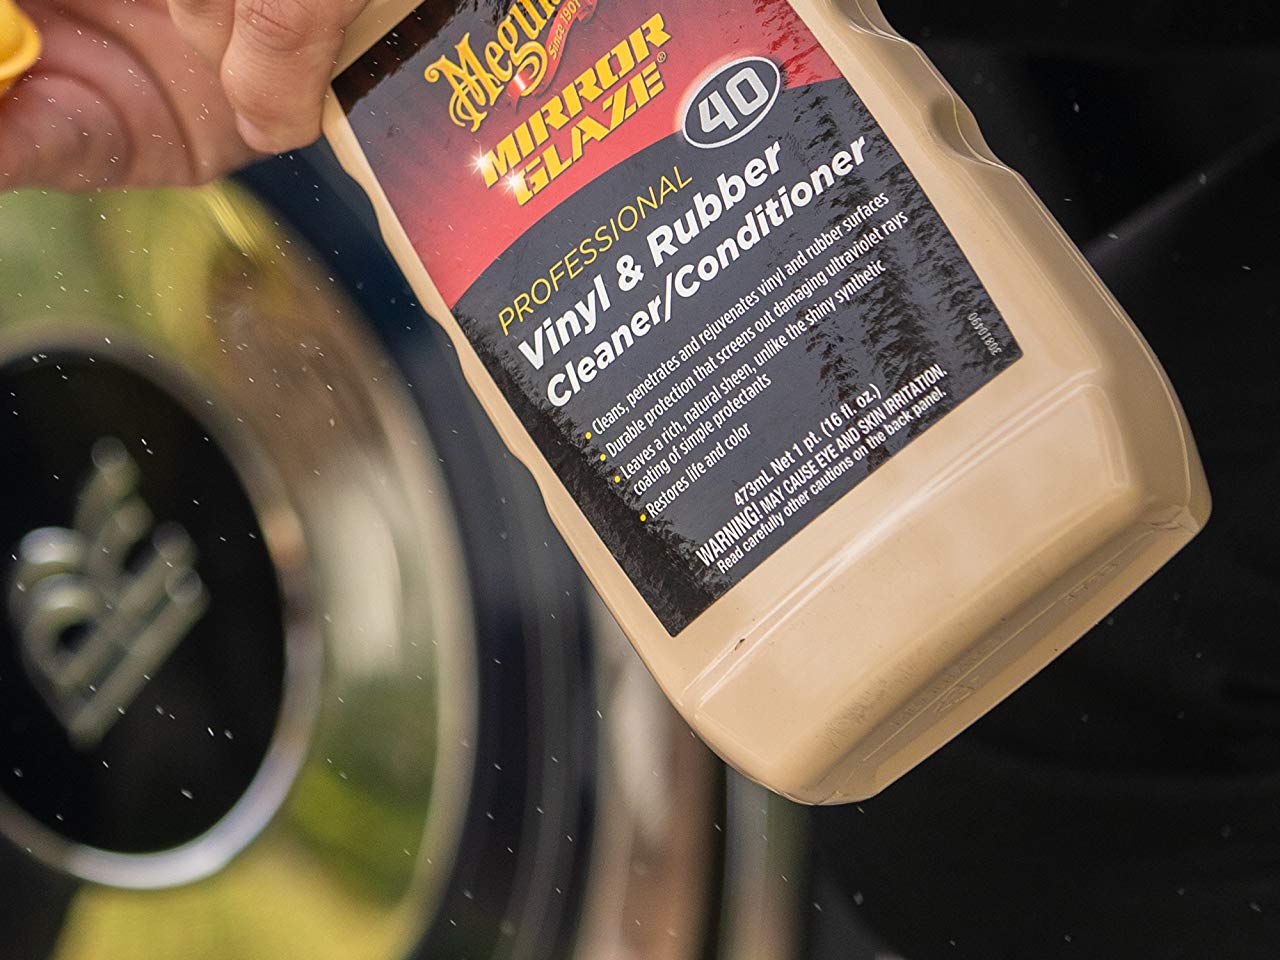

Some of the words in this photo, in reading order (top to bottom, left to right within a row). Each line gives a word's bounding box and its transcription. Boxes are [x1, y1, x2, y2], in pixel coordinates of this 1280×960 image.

[483, 12, 672, 188] MIRROR
[548, 24, 566, 61] Since
[698, 67, 769, 133] 40
[497, 166, 692, 336] PROFESSIONAL
[517, 273, 611, 370] Vinyl
[615, 254, 645, 292] &
[645, 140, 781, 268] Rubber
[546, 135, 866, 407] Cleaner/Conditioner
[591, 401, 630, 435] Cleans,
[625, 354, 681, 409] penetrates
[677, 335, 701, 362] and
[697, 290, 760, 345] rejuvenates
[756, 266, 787, 296] vinyl
[783, 249, 808, 276] and
[804, 224, 844, 260] rubber
[841, 191, 890, 232] surfaces
[604, 418, 647, 458] Durable
[643, 375, 697, 428] protection
[691, 355, 719, 382] that
[715, 326, 757, 365] screens
[753, 309, 776, 333] out
[772, 270, 829, 318] damaging
[824, 226, 884, 277] ultraviolet
[880, 210, 909, 236] rays
[967, 312, 1003, 356] 30810490
[619, 443, 656, 480] Leaves
[653, 438, 664, 451] a
[660, 420, 687, 444] rich,
[683, 384, 722, 425] natural
[719, 362, 757, 395] sheen,
[752, 334, 789, 367] unlike
[784, 319, 808, 340] the
[804, 296, 837, 326] shiny
[833, 259, 886, 304] synthetic
[632, 458, 671, 496] coating
[667, 444, 682, 465] of
[678, 420, 715, 455] simple
[711, 373, 772, 429] protectants
[733, 468, 775, 506] 473mL
[769, 450, 796, 476] Net
[791, 442, 804, 457] 1
[802, 430, 823, 453] pt.
[819, 411, 843, 438] (16
[839, 402, 858, 419] fl.
[855, 382, 882, 408] oz.)
[645, 475, 690, 519] Restores
[684, 461, 707, 483] life
[703, 441, 727, 468] and
[723, 422, 751, 450] color
[694, 501, 764, 567] WARNING!
[758, 485, 785, 514] MAY
[782, 459, 820, 494] CAUSE
[813, 443, 840, 469] EYE
[835, 426, 861, 453] AND
[857, 406, 887, 435] SKIN
[881, 363, 948, 416] IRRITATION.
[715, 544, 745, 574] Read
[741, 511, 785, 552] carefully
[782, 489, 810, 517] other
[809, 456, 854, 495] cautions
[852, 444, 869, 461] on
[865, 430, 887, 449] the
[882, 410, 914, 436] back
[910, 385, 947, 418] panel.
